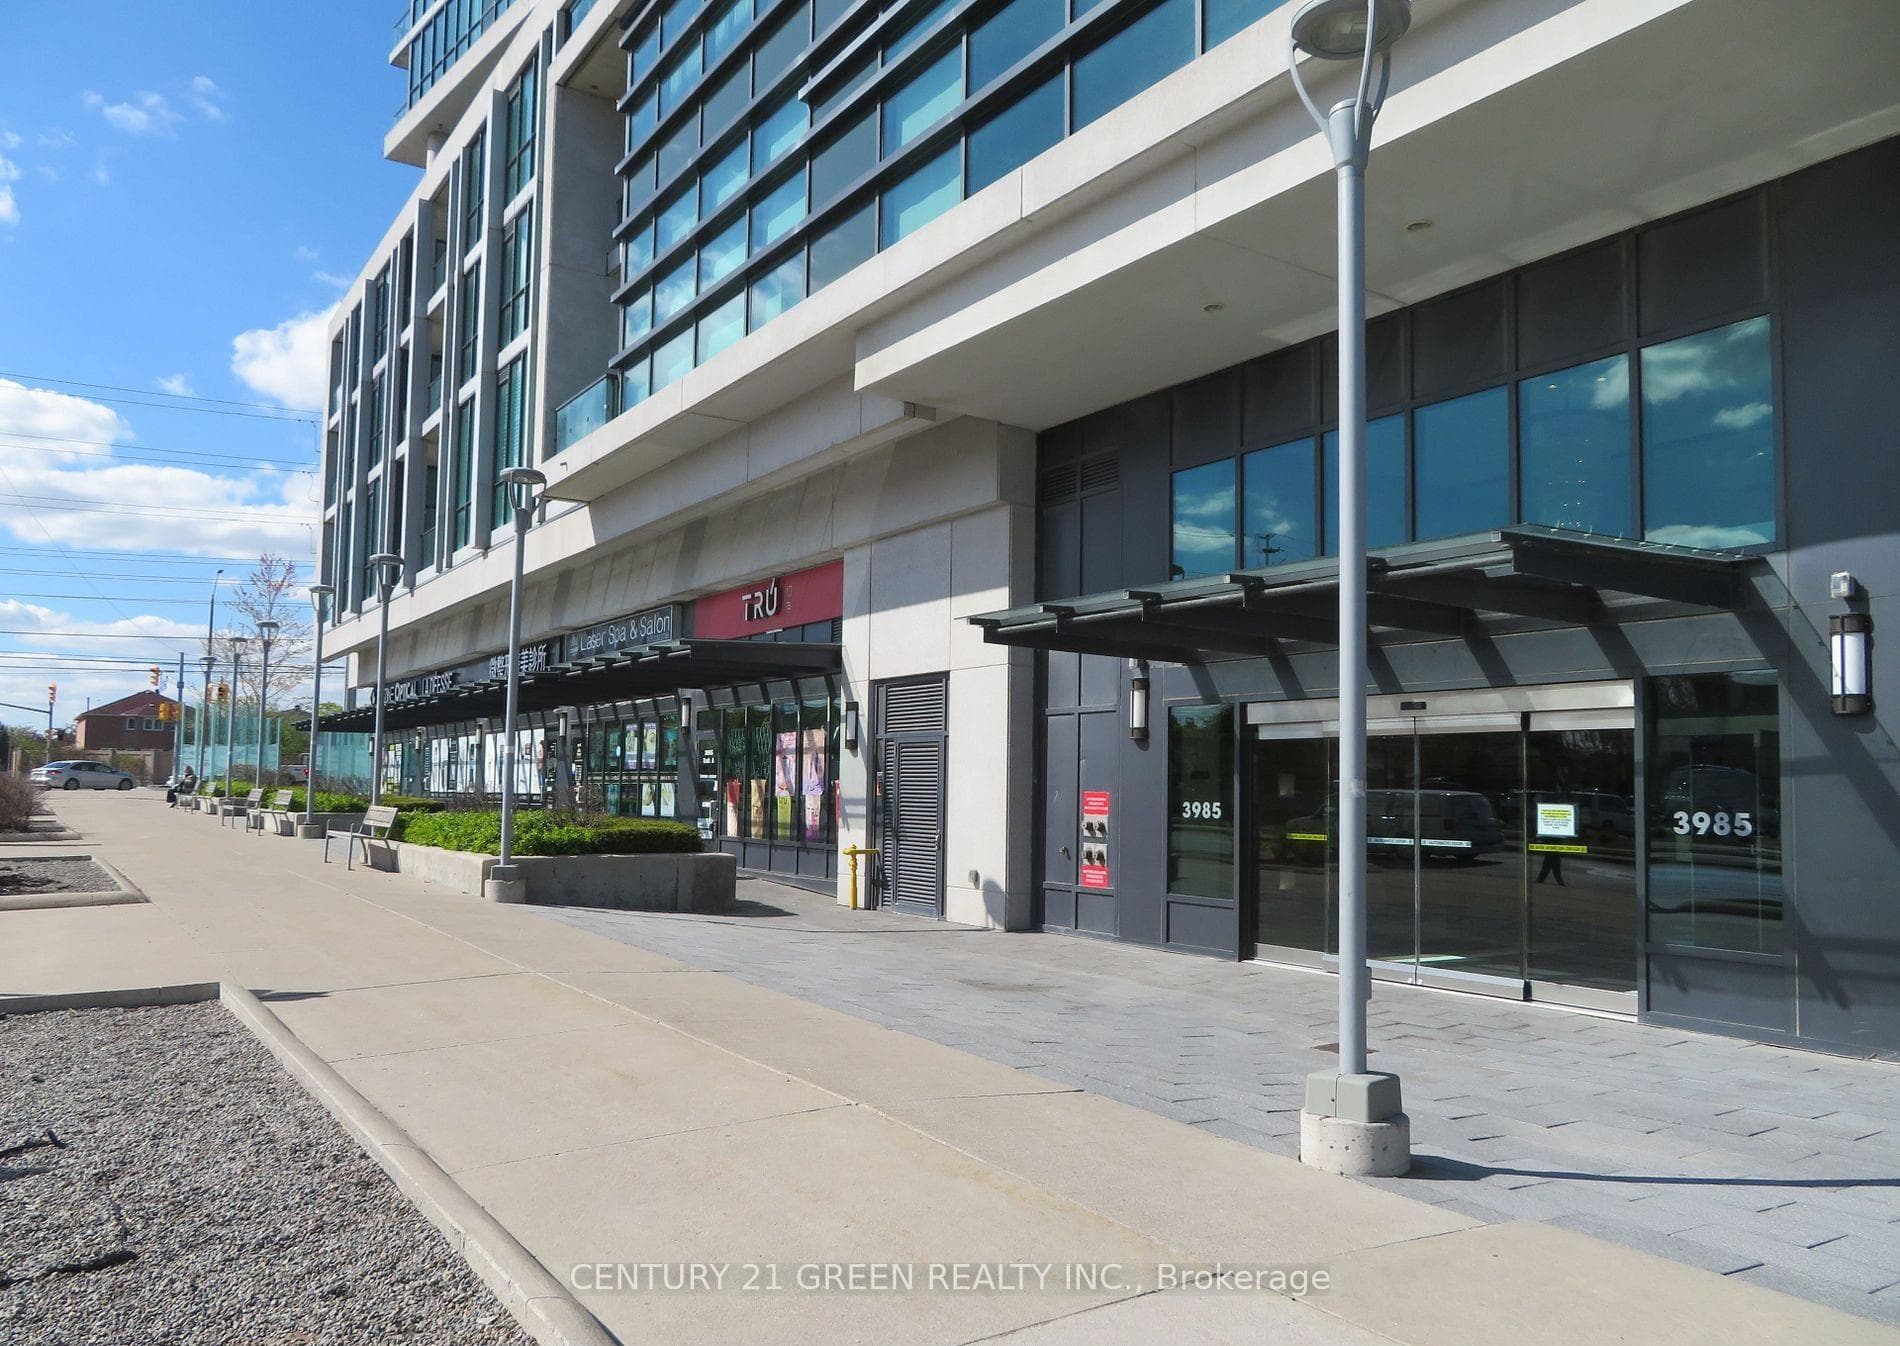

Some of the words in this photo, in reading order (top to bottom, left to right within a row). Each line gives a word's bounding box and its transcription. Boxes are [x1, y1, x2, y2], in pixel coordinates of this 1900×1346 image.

[580, 629, 605, 651] Laser
[608, 624, 627, 648] Spa
[629, 619, 638, 640] &
[640, 612, 670, 637] Salon
[1182, 801, 1222, 819] 3985
[1673, 811, 1753, 837] 3985
